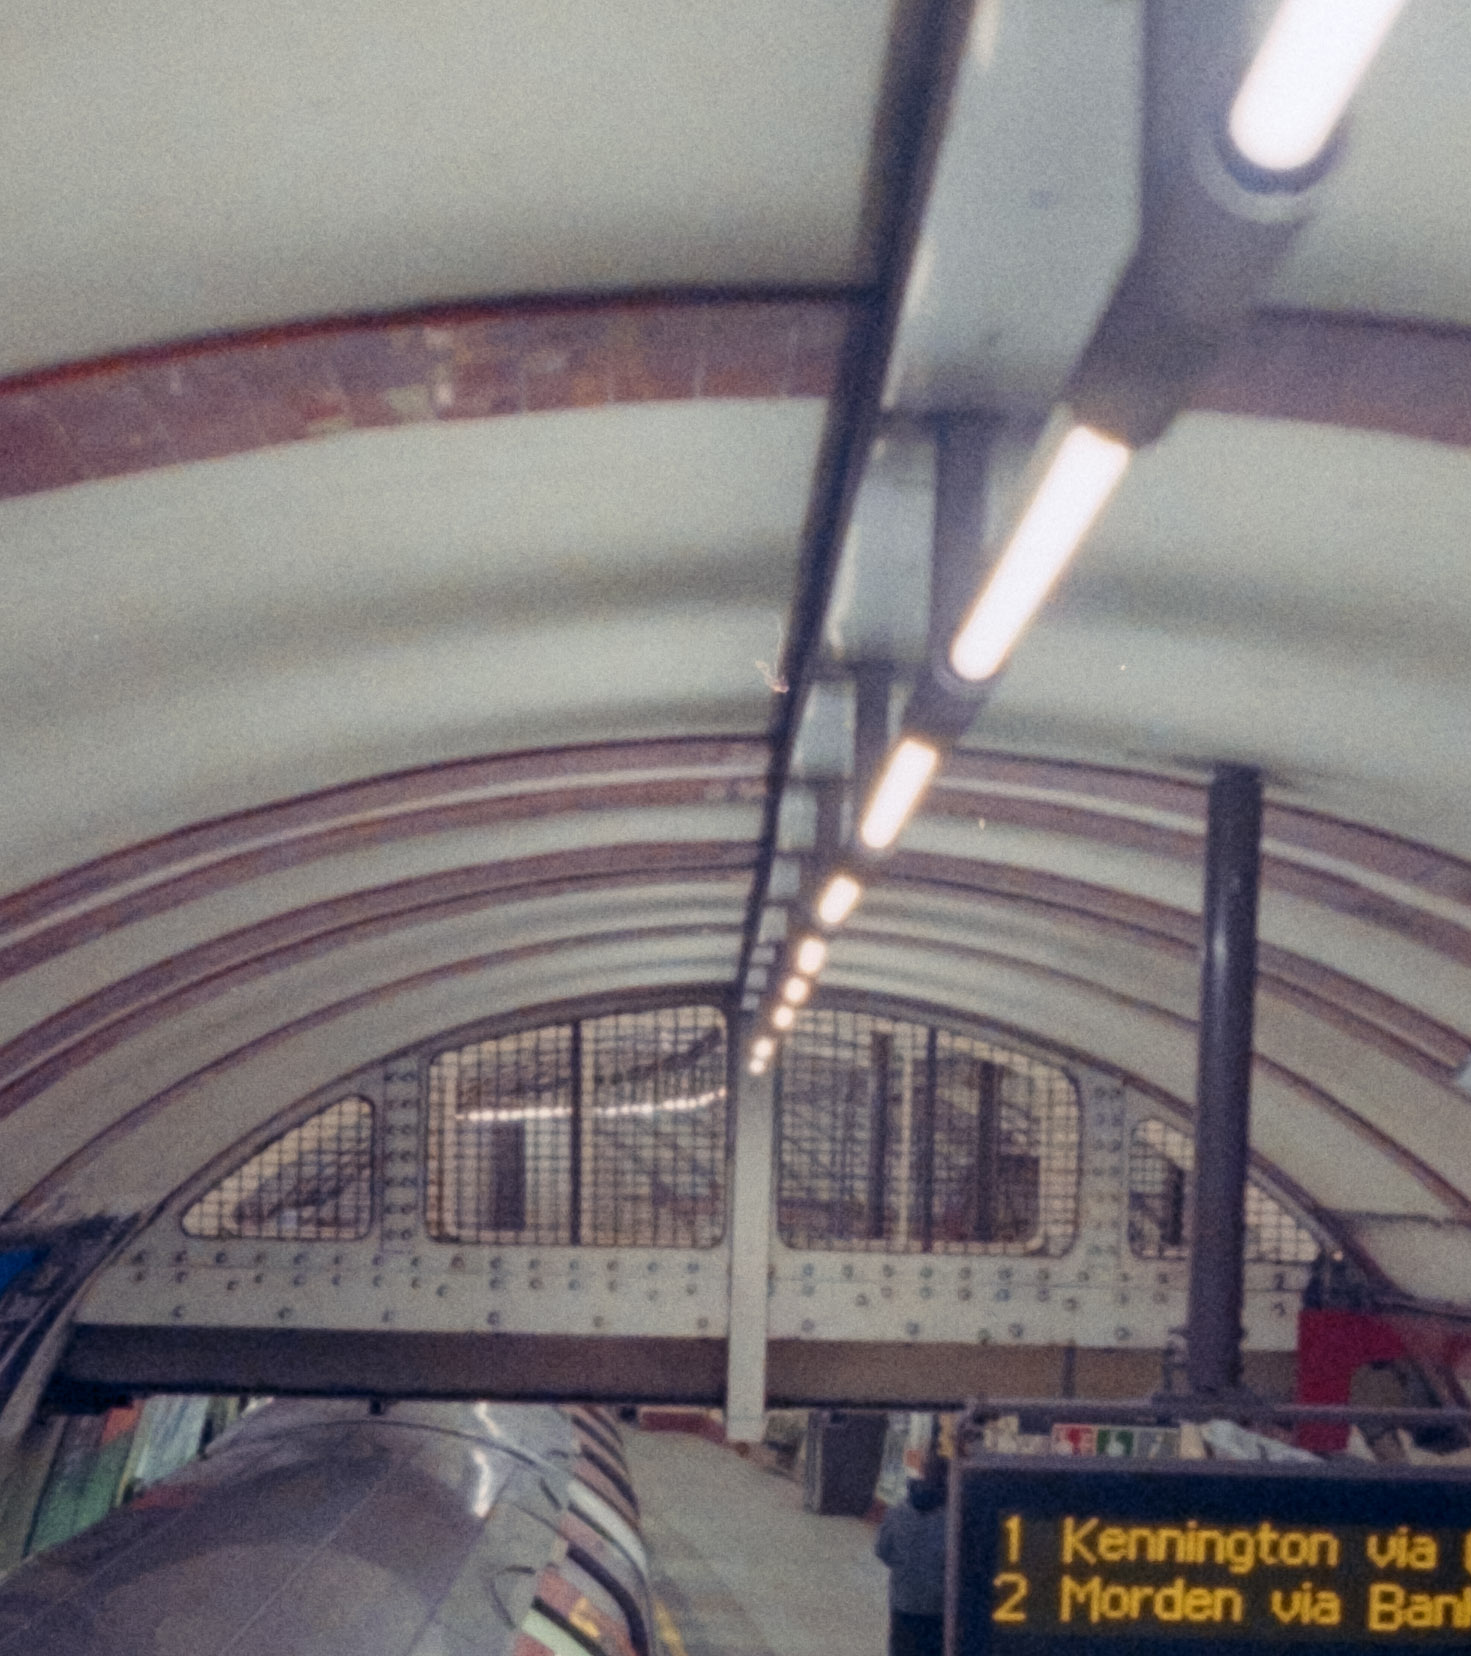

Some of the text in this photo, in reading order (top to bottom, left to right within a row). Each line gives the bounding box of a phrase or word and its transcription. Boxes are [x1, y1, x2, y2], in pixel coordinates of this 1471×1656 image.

[1004, 1514, 1022, 1564] 1
[1060, 1515, 1341, 1575] Kennington
[1365, 1525, 1439, 1570] via
[992, 1572, 1029, 1622] 2
[1058, 1574, 1244, 1624] Morden
[1269, 1581, 1342, 1626] via
